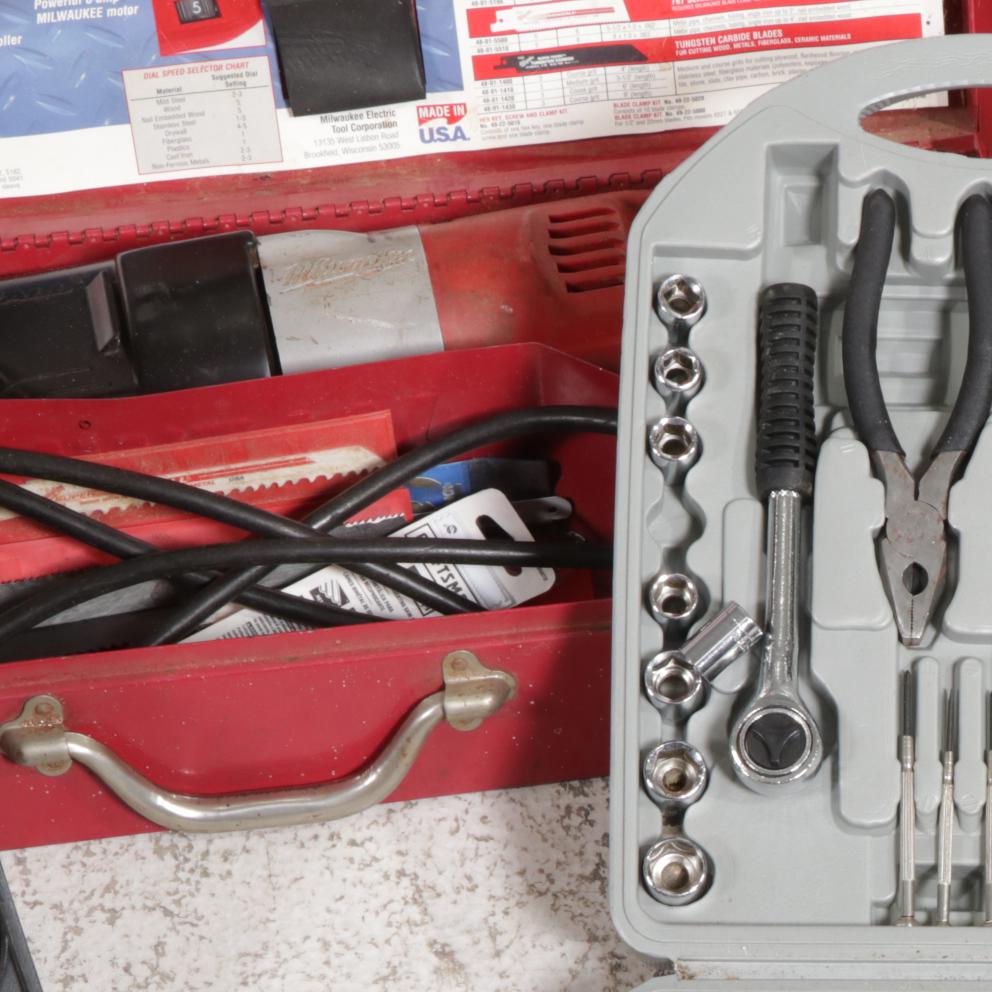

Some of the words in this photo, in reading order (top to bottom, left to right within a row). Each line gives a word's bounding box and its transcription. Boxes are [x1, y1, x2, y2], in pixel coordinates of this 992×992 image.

[36, 7, 103, 24] MILWAUKEE
[107, 5, 138, 17] motor
[192, 1, 202, 14] 5
[674, 38, 716, 49] TUNGSTEN
[718, 33, 750, 44] CARBIDE
[753, 30, 783, 40] BLADES
[144, 72, 160, 80] DIAL
[162, 69, 184, 78] SPEED
[188, 64, 222, 74] SELECTOR
[226, 62, 249, 70] CHART
[212, 72, 244, 81] Suggested
[246, 70, 258, 78] Dial
[156, 86, 182, 95] Material
[225, 80, 246, 88] Setting
[320, 110, 364, 124] Milwaukee
[366, 108, 396, 120] Electric
[419, 106, 451, 118] MADE
[454, 104, 465, 116] IN
[332, 123, 348, 134] Tool
[350, 120, 398, 133] Corporation
[338, 135, 355, 144] West
[381, 131, 399, 140] Road
[419, 125, 470, 144] U.S.A.
[342, 144, 377, 155] Wisconsin
